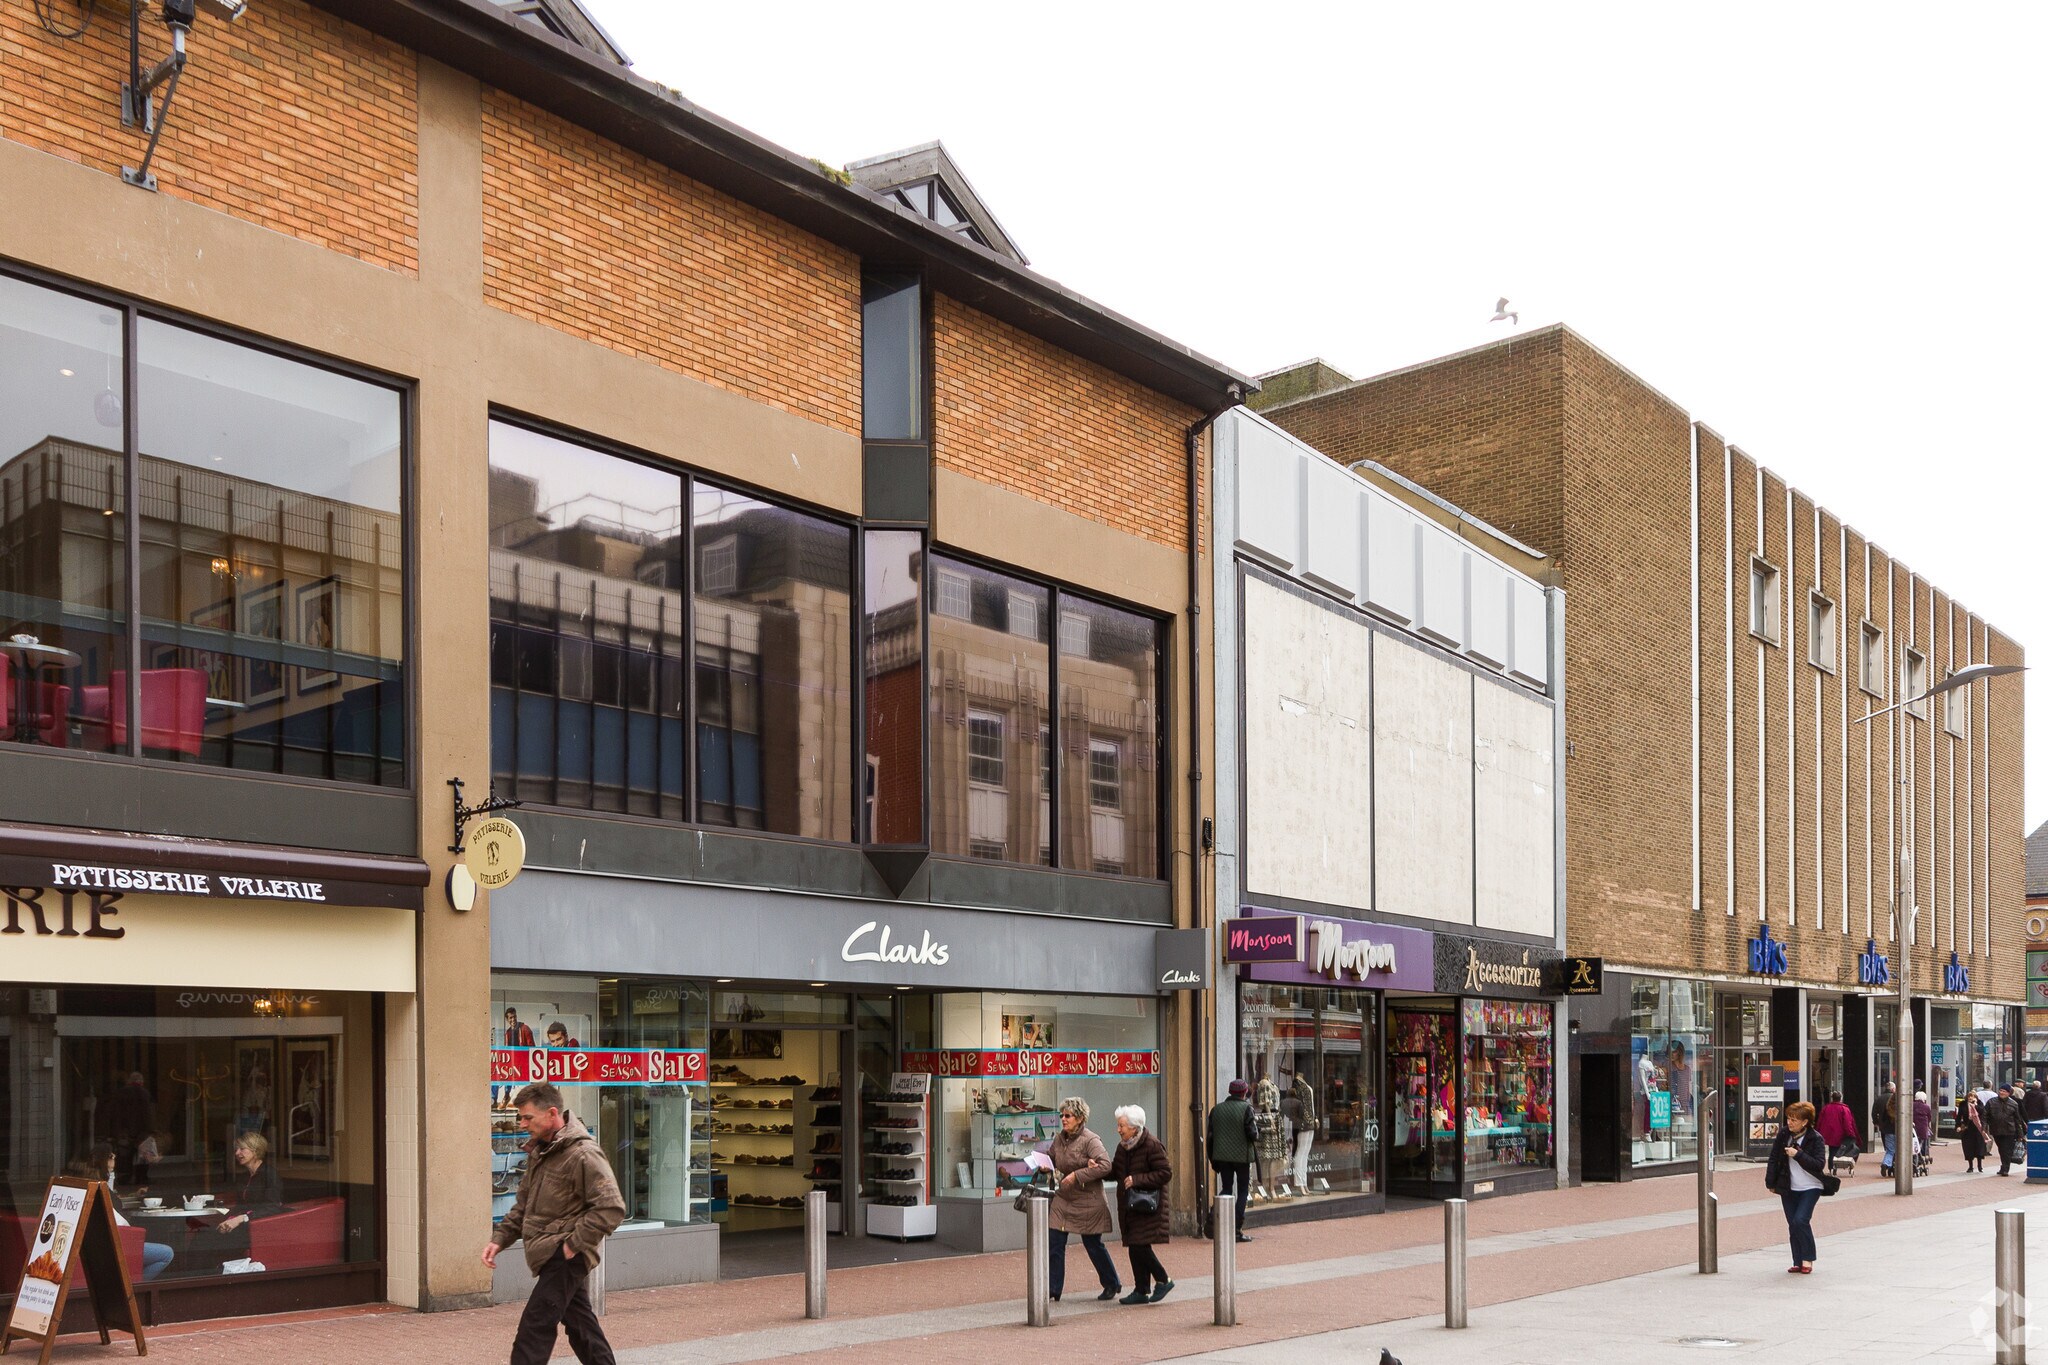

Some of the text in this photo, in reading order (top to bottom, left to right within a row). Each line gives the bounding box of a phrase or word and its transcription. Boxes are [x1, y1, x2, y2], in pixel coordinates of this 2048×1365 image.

[472, 822, 513, 844] PATISSERIE
[52, 864, 326, 901] PATISSERIE VALERIE
[480, 868, 510, 884] VALERIE
[842, 921, 950, 966] Clarks
[1231, 930, 1292, 952] Monsoon
[1310, 920, 1396, 982] Monsoon
[1162, 970, 1200, 984] Clarks
[1464, 946, 1540, 992] Accessorize
[1242, 1016, 1260, 1028] acket
[612, 1054, 632, 1064] MID
[492, 1065, 522, 1080] ASON
[1365, 1124, 1379, 1142] 40
[50, 1194, 80, 1214] Early Riser
